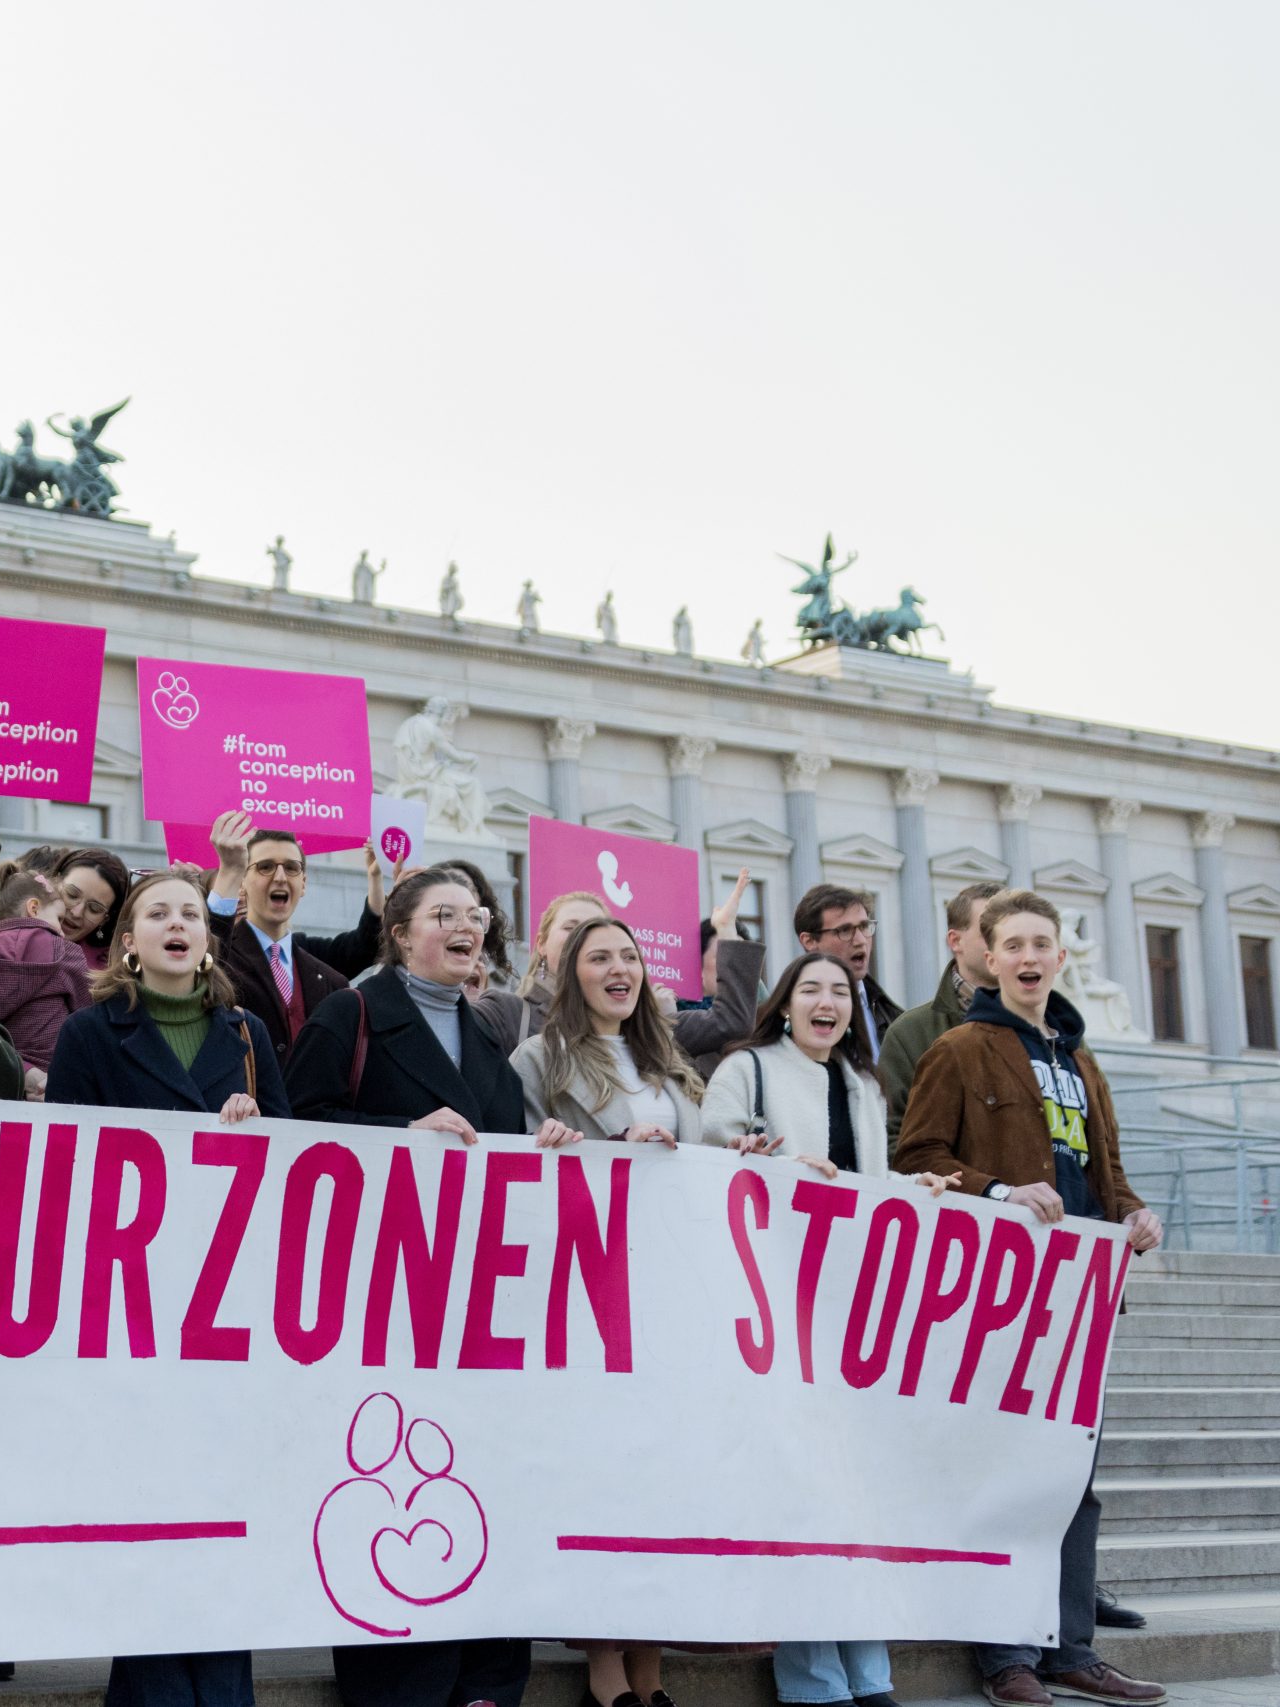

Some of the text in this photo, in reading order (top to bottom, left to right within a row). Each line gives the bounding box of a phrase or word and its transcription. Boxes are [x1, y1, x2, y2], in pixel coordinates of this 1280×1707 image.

[223, 734, 287, 758] #from
[239, 760, 356, 784] conception
[240, 779, 268, 794] no
[241, 798, 344, 820] exception
[657, 931, 682, 948] SICH
[646, 963, 684, 981] RIGEN.
[727, 1168, 1133, 1428] STOPPEN
